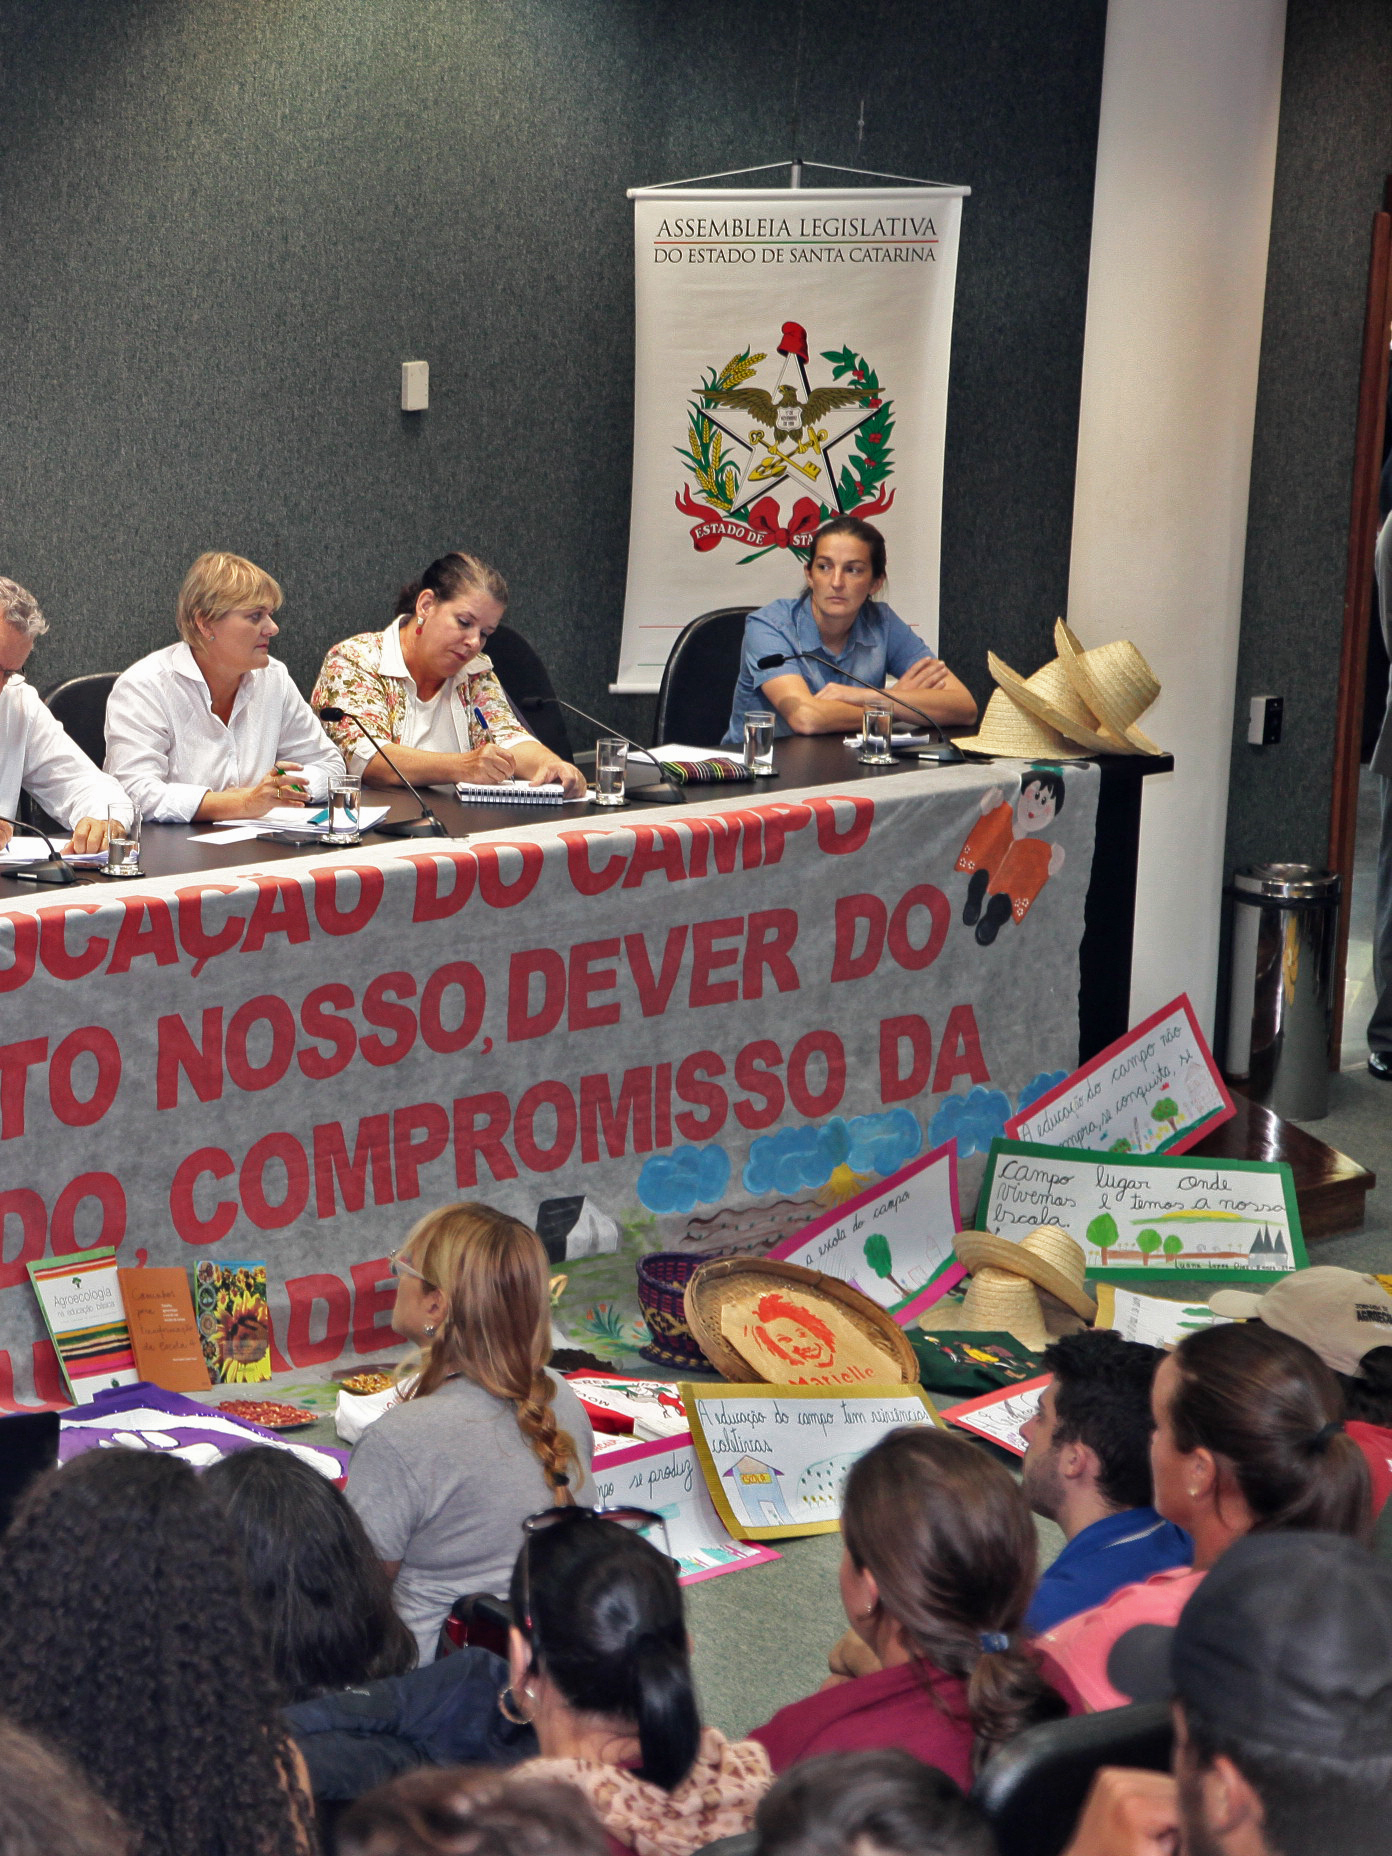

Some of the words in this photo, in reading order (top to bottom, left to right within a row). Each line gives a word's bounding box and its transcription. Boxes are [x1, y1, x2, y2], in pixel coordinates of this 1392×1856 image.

[656, 218, 792, 238] ASSEMBLEIA
[800, 217, 937, 237] LEGISLATIVA
[654, 248, 682, 263] DO
[688, 248, 755, 263] ESTADO
[762, 248, 784, 263] DE
[789, 248, 848, 263] SANTA
[849, 247, 936, 263] CATARINA
[695, 523, 745, 539] ESTADO
[747, 532, 764, 545] DE
[402, 841, 544, 923] DO
[557, 796, 875, 896] CAMPO
[508, 908, 800, 1043] DEVER
[831, 884, 951, 982] DO
[1021, 1119, 1034, 1142] A
[1086, 1078, 1102, 1102] do
[1111, 1043, 1156, 1084] campo
[1160, 1025, 1182, 1046] não
[170, 1030, 846, 1245] COMPROMISSO
[880, 1004, 991, 1104] DA
[1096, 1165, 1151, 1202] lugar
[1130, 1193, 1184, 1210] temos
[1219, 1199, 1286, 1212] nossa
[54, 1286, 112, 1309] Agroecologia
[698, 1399, 713, 1426] A
[715, 1400, 767, 1429] educação
[773, 1400, 789, 1424] do
[797, 1411, 835, 1437] campo
[841, 1400, 867, 1424] tem
[628, 1472, 644, 1489] se
[648, 1451, 693, 1499] produz
